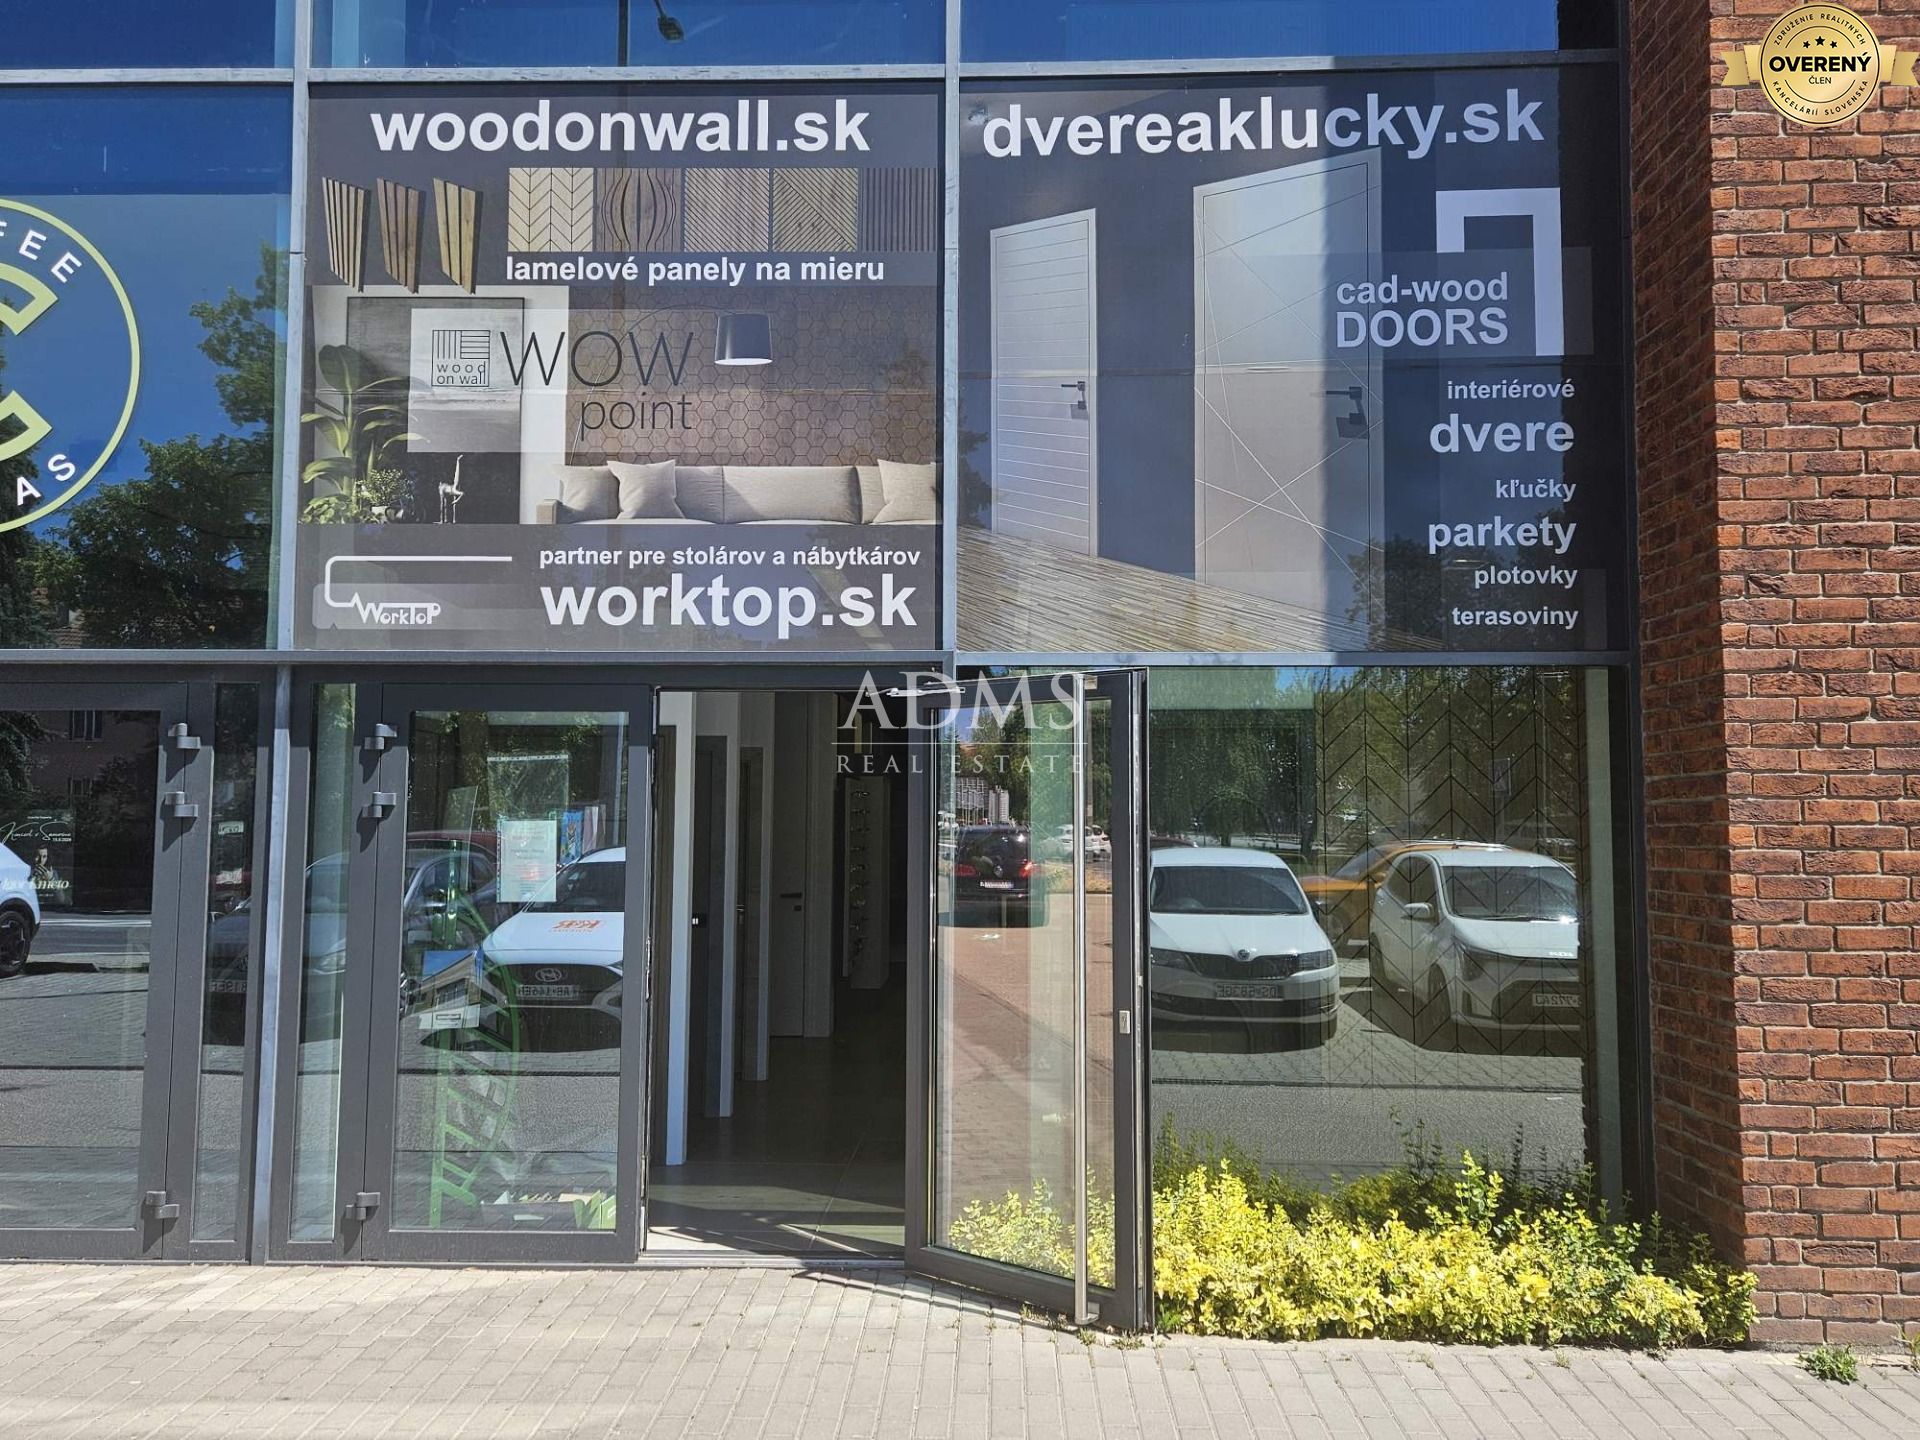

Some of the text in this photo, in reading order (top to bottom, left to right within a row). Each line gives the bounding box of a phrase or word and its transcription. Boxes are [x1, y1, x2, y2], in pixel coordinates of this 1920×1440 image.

[370, 99, 870, 153] woodonwall.sk
[983, 88, 1545, 160] dvereaklucky.sk
[505, 256, 884, 286] lamelové panely na mieru
[1336, 271, 1508, 304] cad-wood
[1336, 307, 1509, 348] DOORS
[436, 360, 486, 373] wood
[500, 331, 694, 387] WOW
[436, 371, 486, 385] on wall
[1448, 379, 1575, 399] interiérové
[580, 391, 692, 441] point
[1429, 414, 1575, 453] dvere
[1496, 479, 1576, 502] kľučky
[1429, 516, 1576, 554] parkety
[540, 546, 920, 569] partner pre stolárov a nábytkárov
[1474, 566, 1577, 588] plotovky
[540, 573, 917, 640] worktop.sk
[1452, 607, 1578, 629] terasoviny
